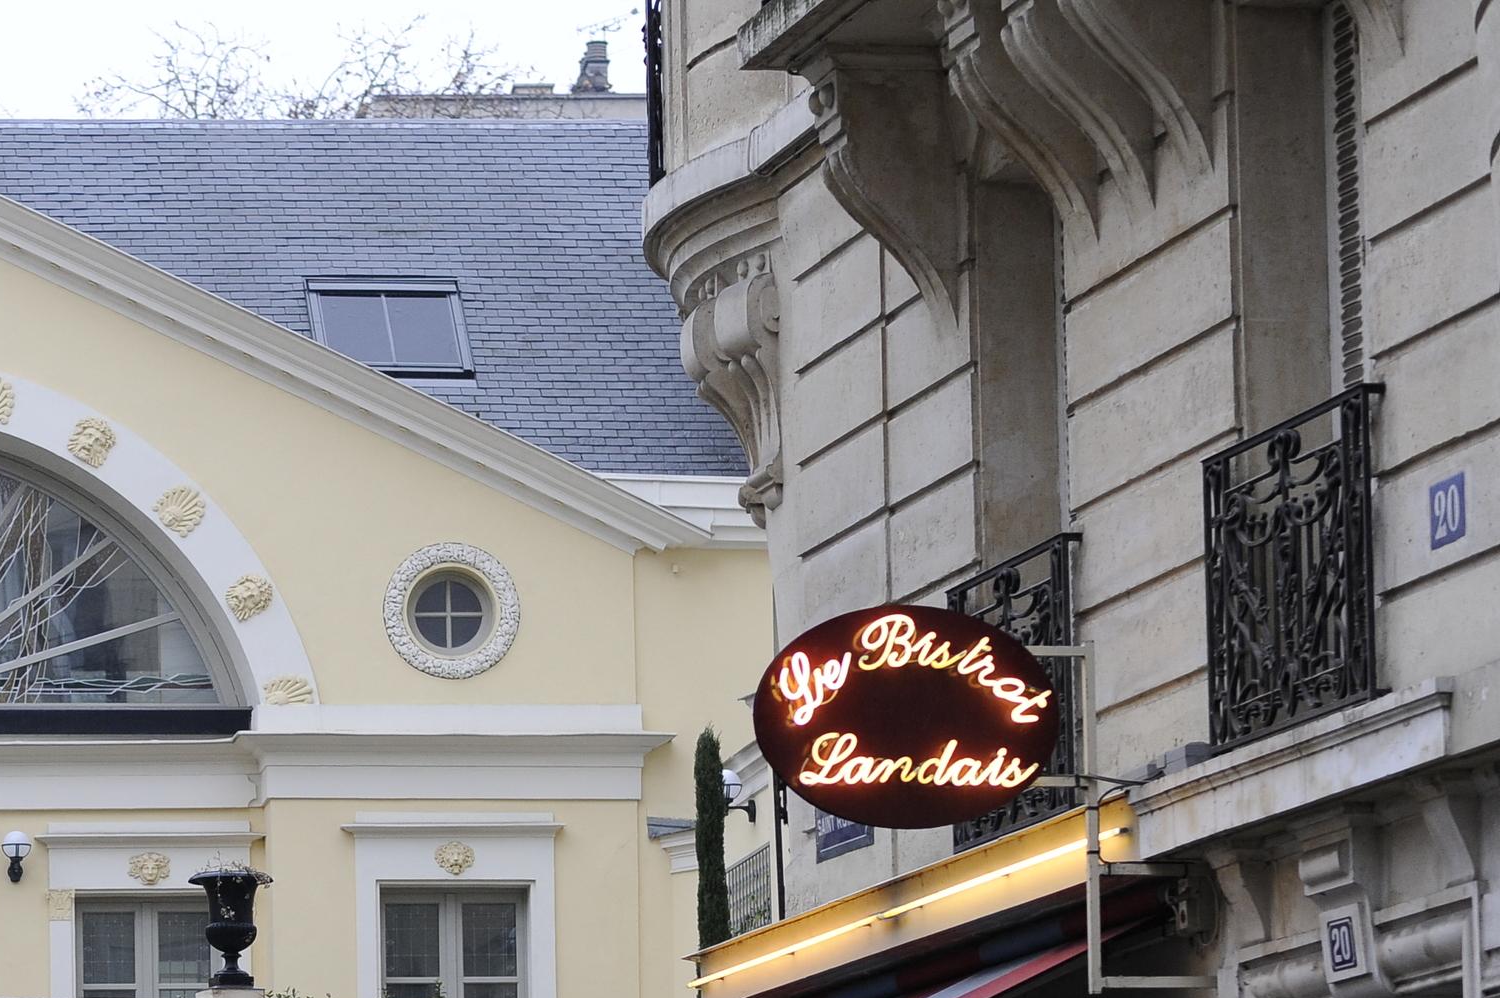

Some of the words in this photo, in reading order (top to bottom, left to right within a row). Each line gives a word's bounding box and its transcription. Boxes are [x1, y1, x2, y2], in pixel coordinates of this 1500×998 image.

[1434, 484, 1460, 540] 20
[777, 651, 853, 727] Le
[857, 613, 1052, 724] Bistrot
[799, 732, 1041, 789] Landais
[817, 814, 835, 837] SAINT
[1331, 925, 1351, 963] 20
